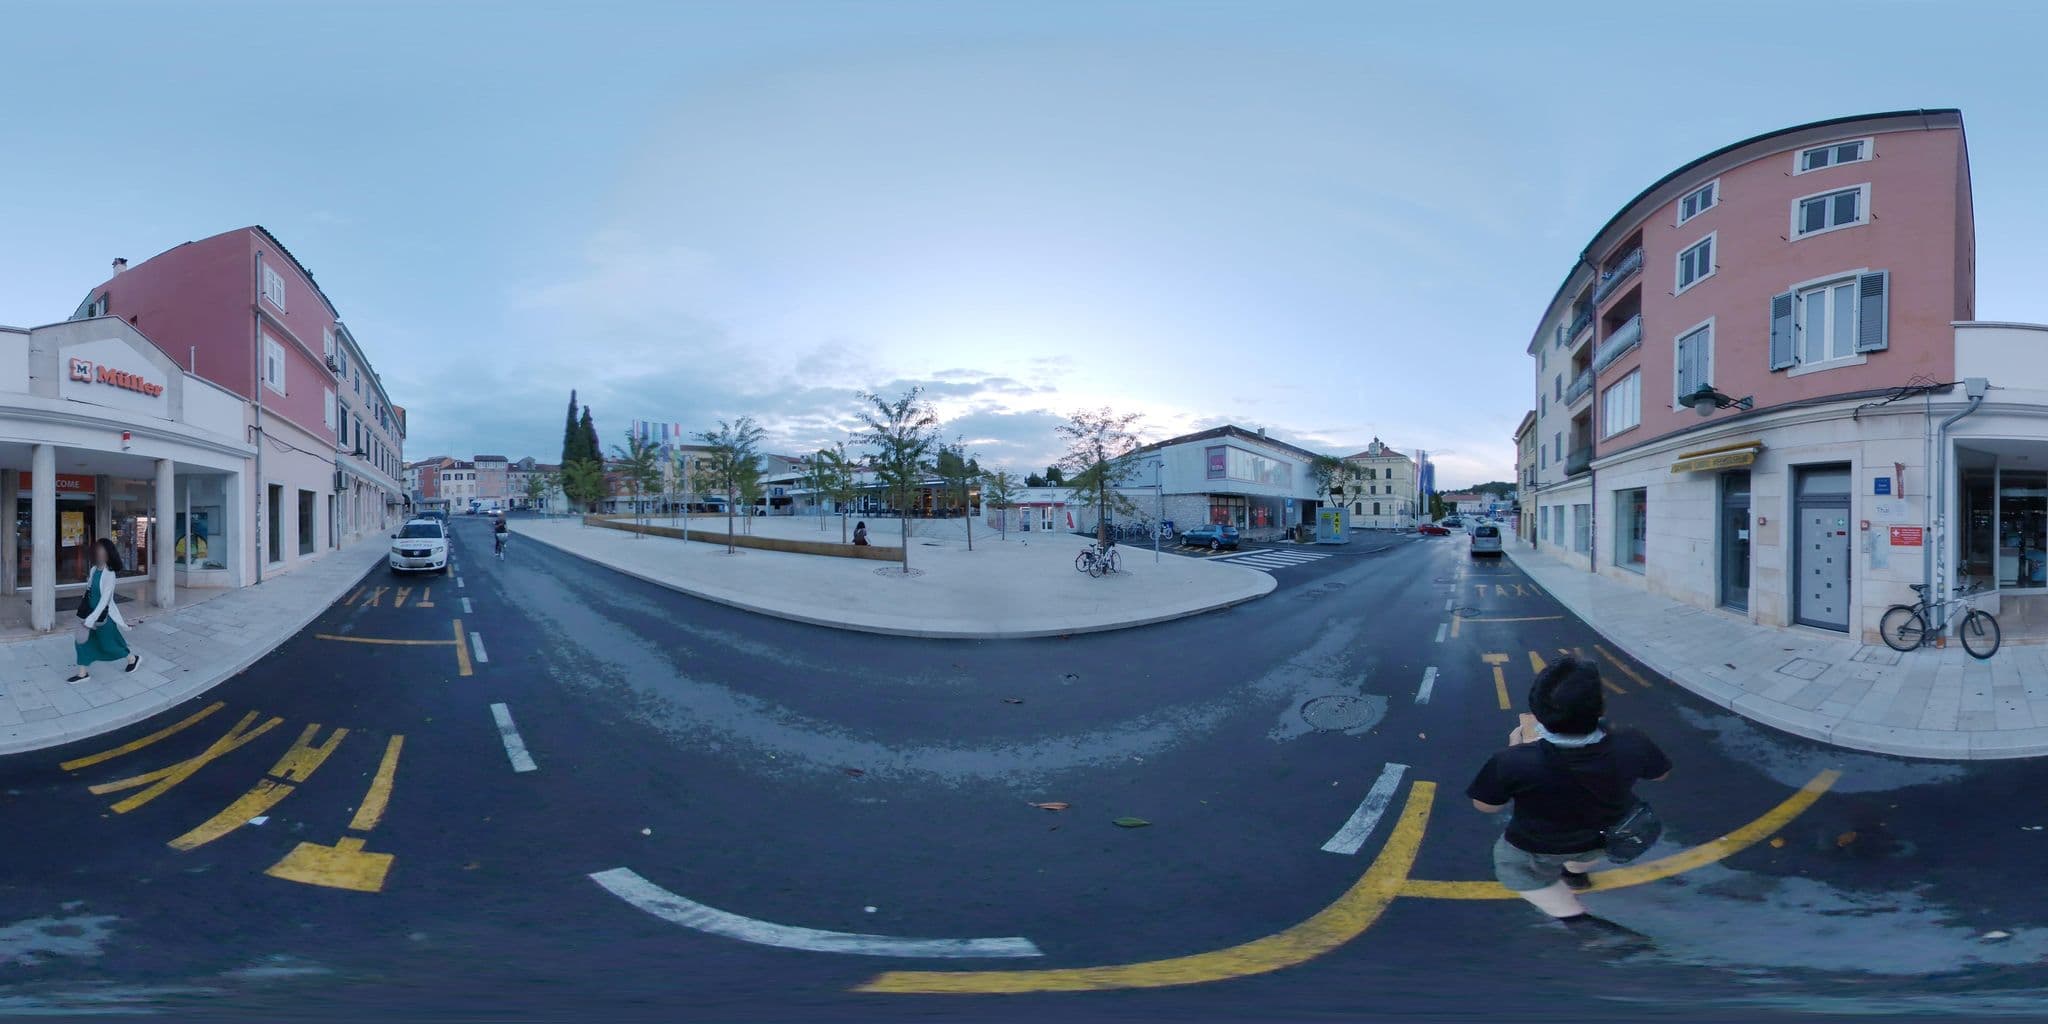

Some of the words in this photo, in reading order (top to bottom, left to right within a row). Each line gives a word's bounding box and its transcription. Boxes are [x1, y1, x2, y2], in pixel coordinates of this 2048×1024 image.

[77, 364, 88, 375] M
[96, 365, 163, 397] Müller
[56, 480, 80, 489] COME
[344, 586, 434, 608] TAXI
[1475, 584, 1542, 597] TAXI
[59, 701, 404, 893] TAXI
